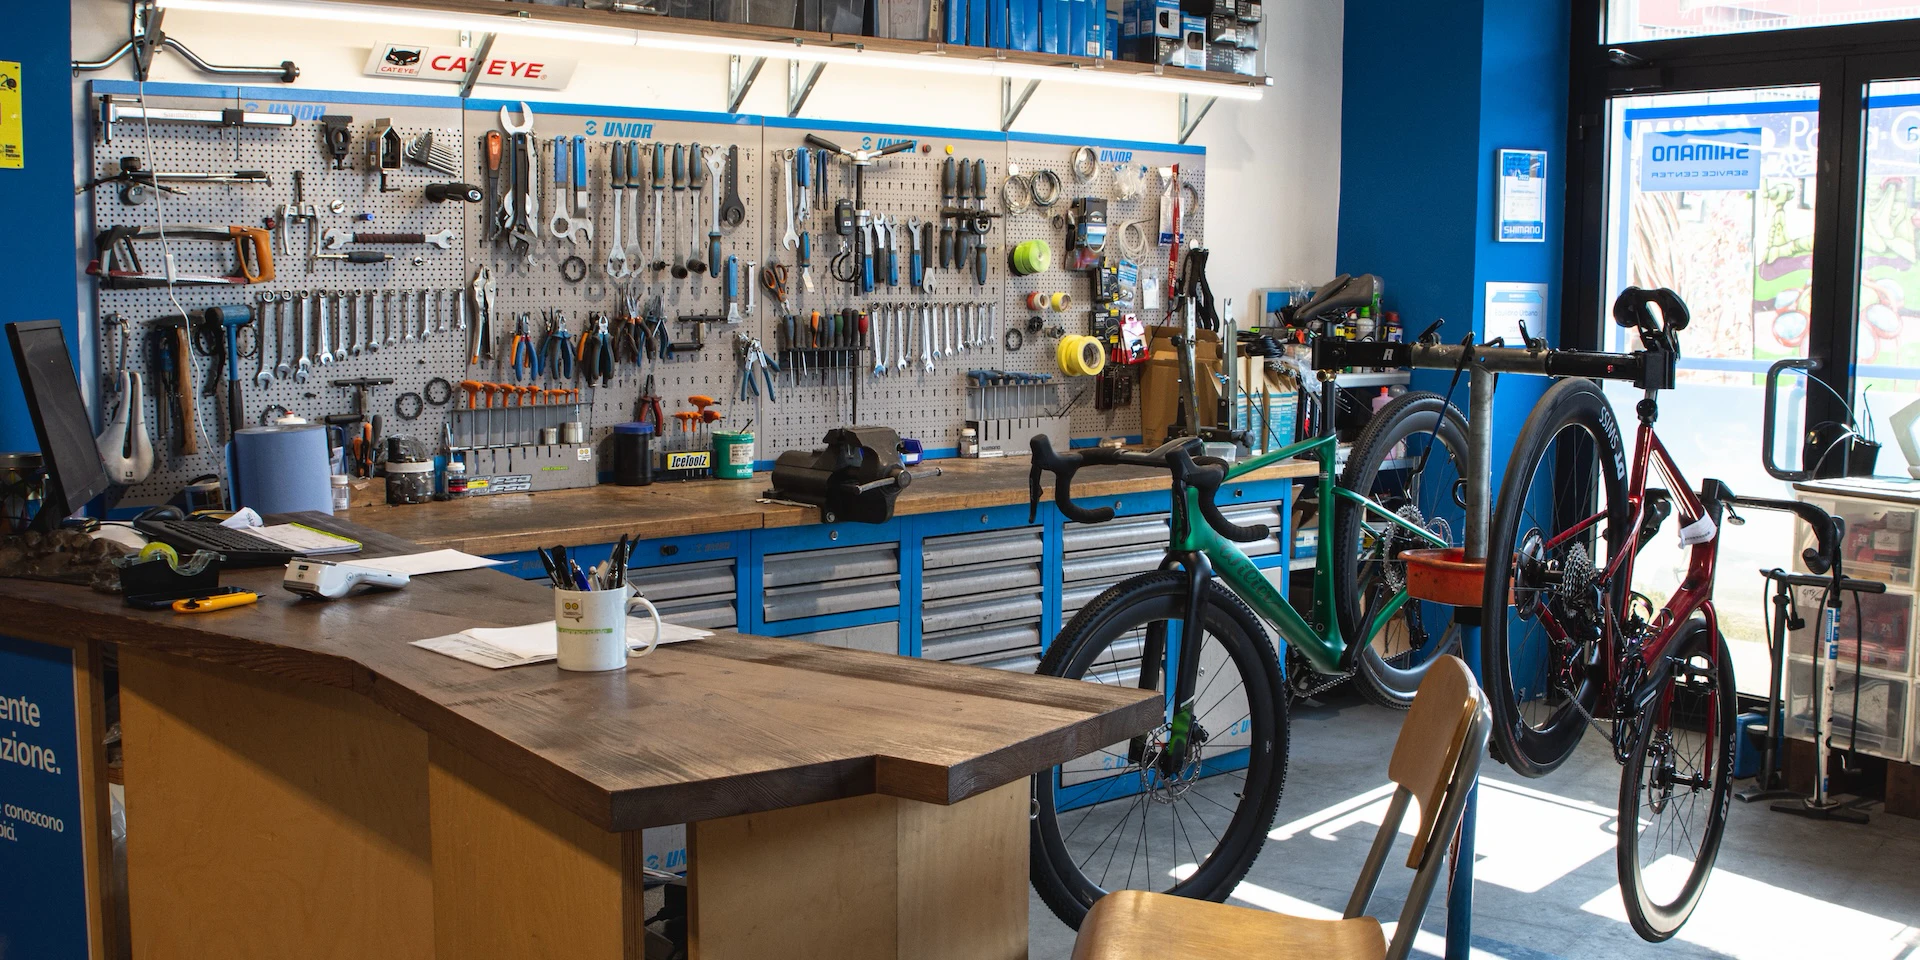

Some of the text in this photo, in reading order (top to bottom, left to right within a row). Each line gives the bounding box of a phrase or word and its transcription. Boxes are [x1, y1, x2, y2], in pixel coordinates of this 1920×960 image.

[380, 66, 414, 75] CATEYE
[431, 55, 544, 78] CAEYE
[268, 103, 326, 121] UNIOR
[603, 121, 653, 139] UNIOR
[1100, 150, 1133, 163] UNIOR
[1504, 225, 1541, 235] SHIMANO
[1383, 348, 1394, 361] R
[1599, 406, 1626, 480] DT SWISS
[671, 454, 707, 468] IceToolz
[1720, 732, 1736, 821] DT SWISS
[4, 802, 65, 833] conoscono
